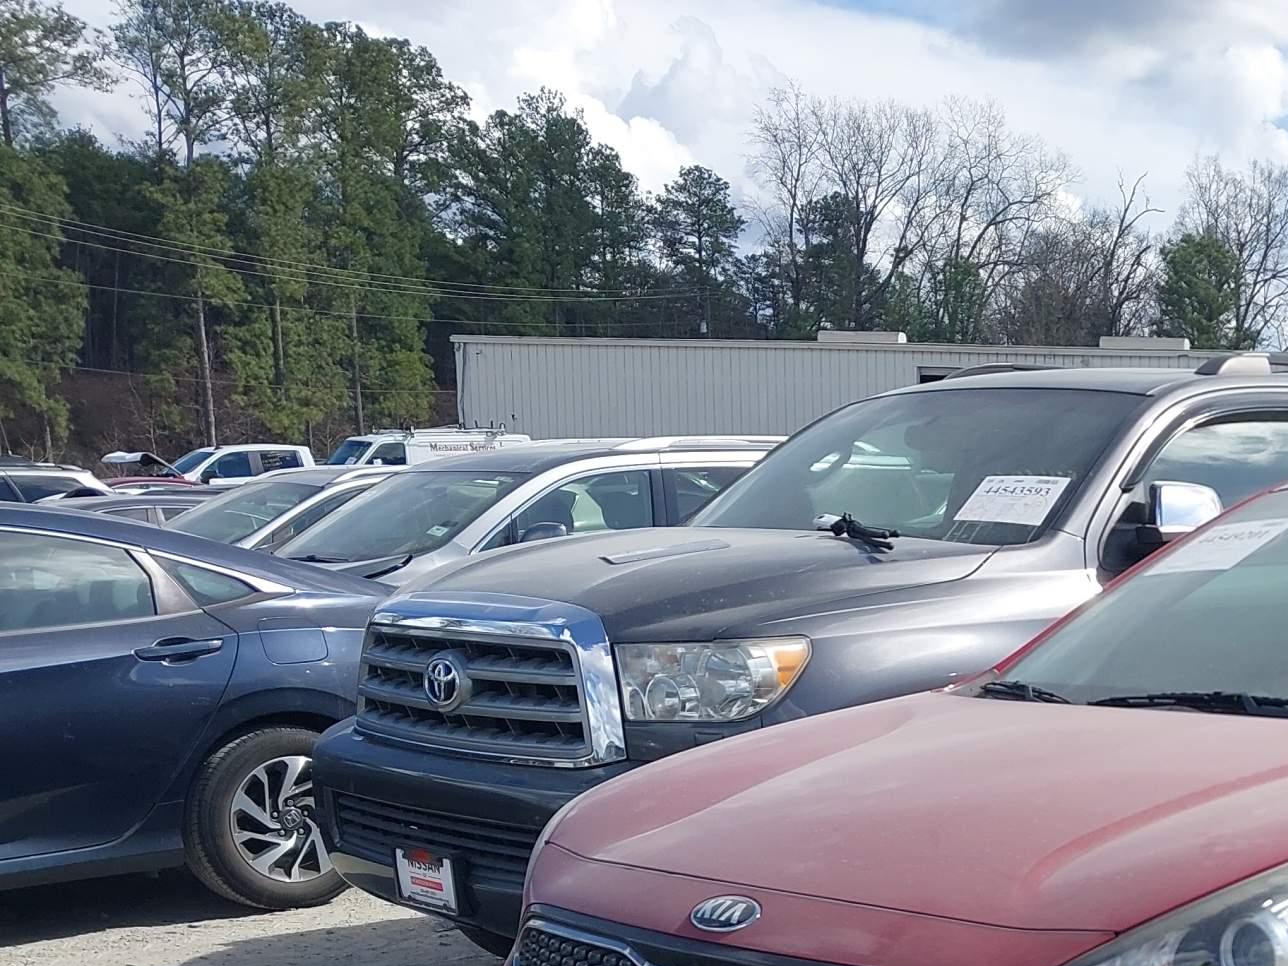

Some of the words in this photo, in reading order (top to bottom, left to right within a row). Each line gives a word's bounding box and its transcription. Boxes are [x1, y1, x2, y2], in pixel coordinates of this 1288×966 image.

[429, 442, 468, 452] Mechanical
[469, 442, 496, 453] Services
[984, 486, 1051, 496] 44543593
[696, 899, 747, 924] KIA
